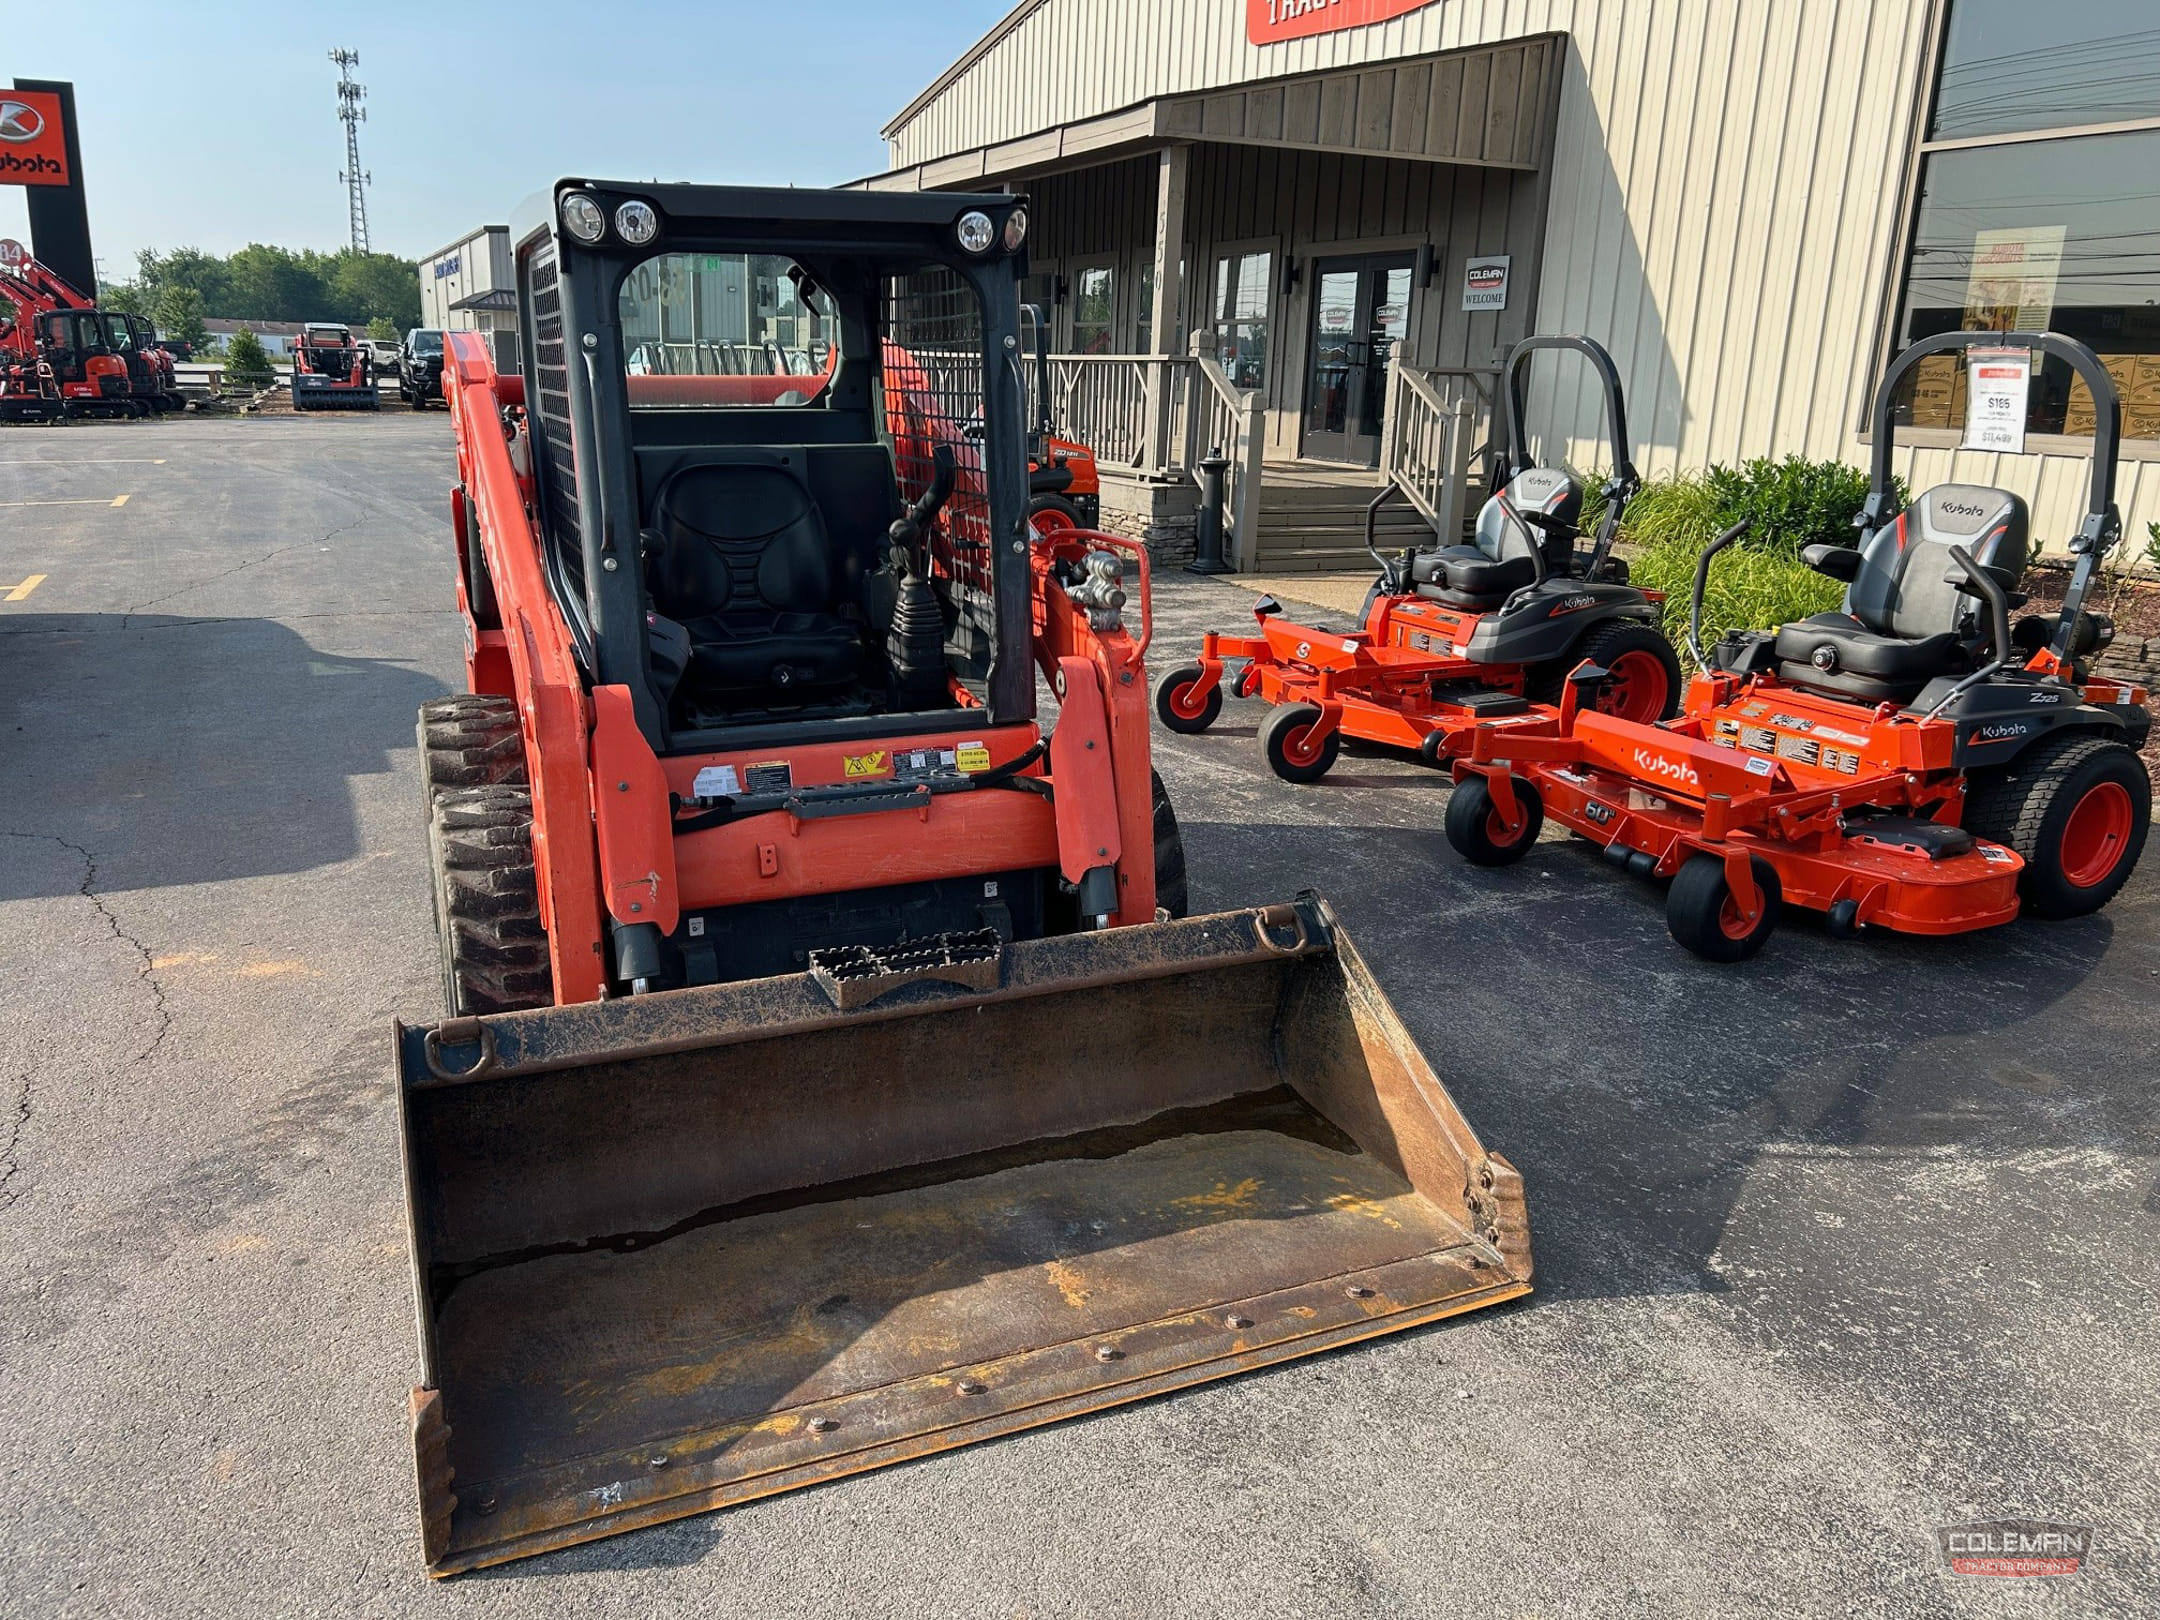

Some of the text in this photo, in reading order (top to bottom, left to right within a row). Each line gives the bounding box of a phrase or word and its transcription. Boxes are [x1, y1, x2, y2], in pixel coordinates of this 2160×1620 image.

[1469, 269, 1504, 280] COLEMAN
[1466, 293, 1504, 304] WELCOME
[1940, 502, 1984, 517] Kubota
[1564, 594, 1596, 609] Kubota
[2029, 692, 2060, 703] Z725
[1982, 723, 2027, 738] Kubota
[1633, 747, 1700, 785] Kubota
